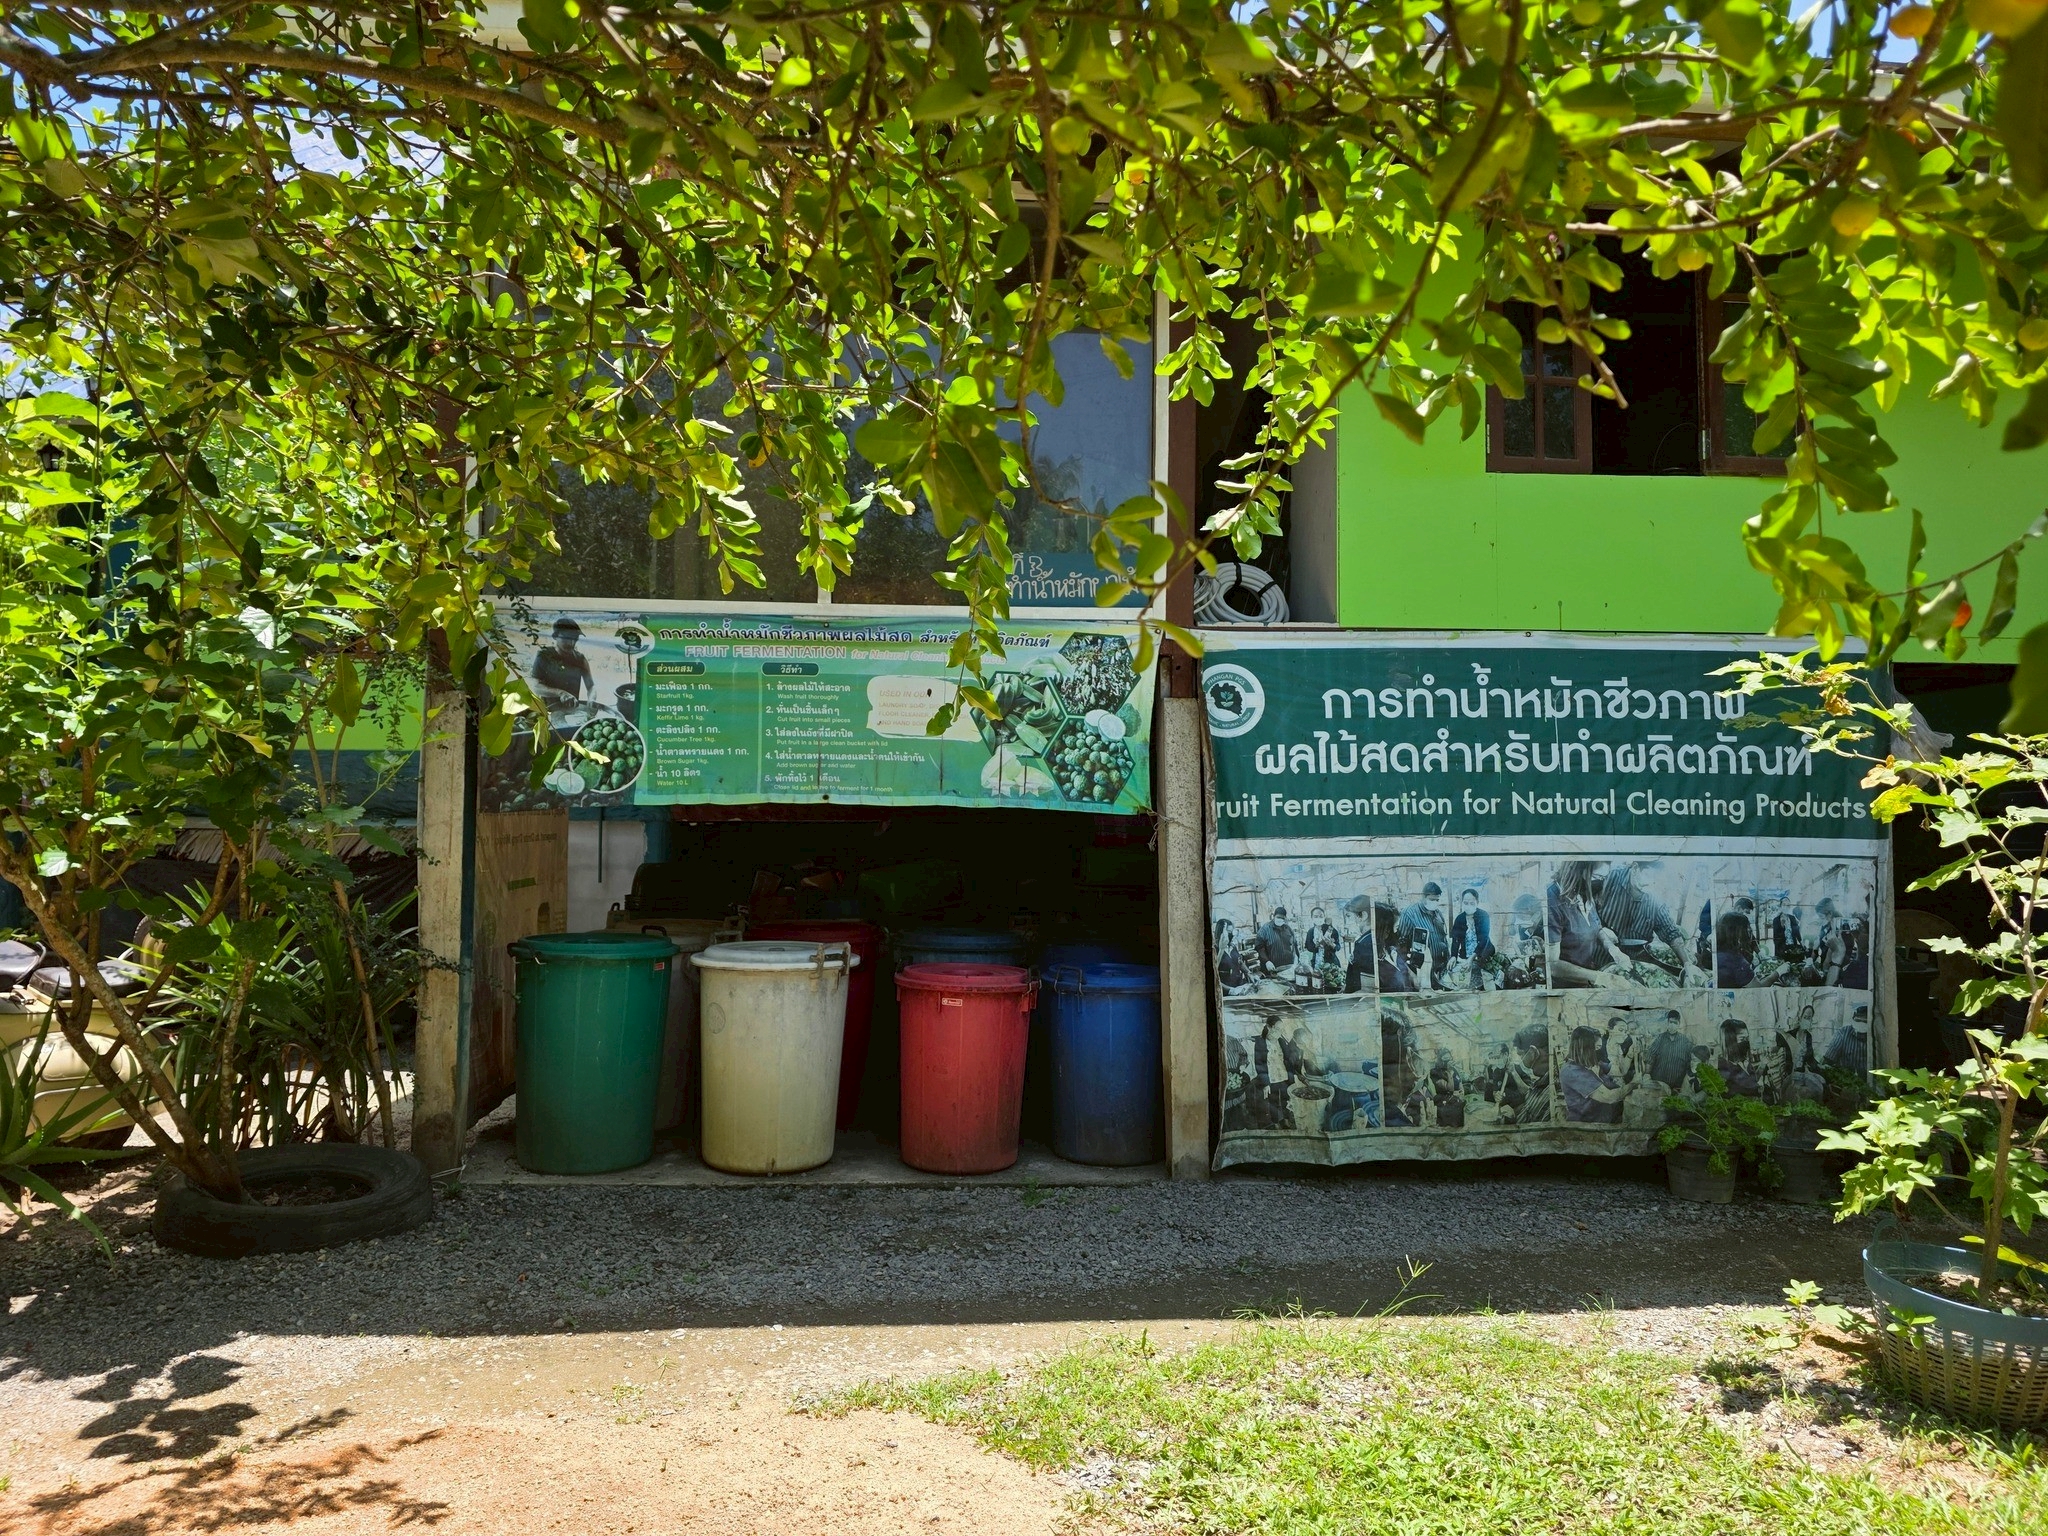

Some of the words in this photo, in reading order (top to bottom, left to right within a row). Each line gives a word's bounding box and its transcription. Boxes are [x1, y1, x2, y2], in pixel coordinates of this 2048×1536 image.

[685, 645, 729, 658] FRUIT
[733, 645, 846, 659] FERMENTATION
[851, 649, 869, 660] for
[869, 649, 909, 661] Natural
[656, 663, 693, 673] ส่วนผสม
[780, 664, 802, 674] วิธีทำ
[1207, 674, 1233, 686] PHANGAN
[1234, 676, 1246, 686] PGS
[655, 681, 687, 690] มะเฟือง
[766, 683, 774, 691] 1.
[776, 681, 851, 692] ล้างผลไม้ให้สะอาด
[1321, 662, 1745, 721] การทำน้ำหมักชีวภาพ
[655, 705, 683, 715] มะกรูด
[765, 706, 774, 714] 2.
[655, 724, 695, 734] ตะลิงปลิง
[765, 729, 773, 737] 3.
[655, 743, 724, 756] น้ำตาลทรายแดง
[1255, 728, 1814, 777] ผลไม้สดสำหรับทำผลิตภัณฑ์
[765, 752, 773, 760] 4.
[655, 765, 668, 777] น้ำ
[684, 767, 700, 777] ลิตร
[764, 774, 772, 782] 5.
[1216, 793, 1260, 818] ruit
[1270, 790, 1453, 817] Fermentation
[1463, 788, 1501, 815] for
[1512, 788, 1616, 815] Natural
[1626, 789, 1745, 825] Cleaning
[1755, 791, 1867, 819] Products
